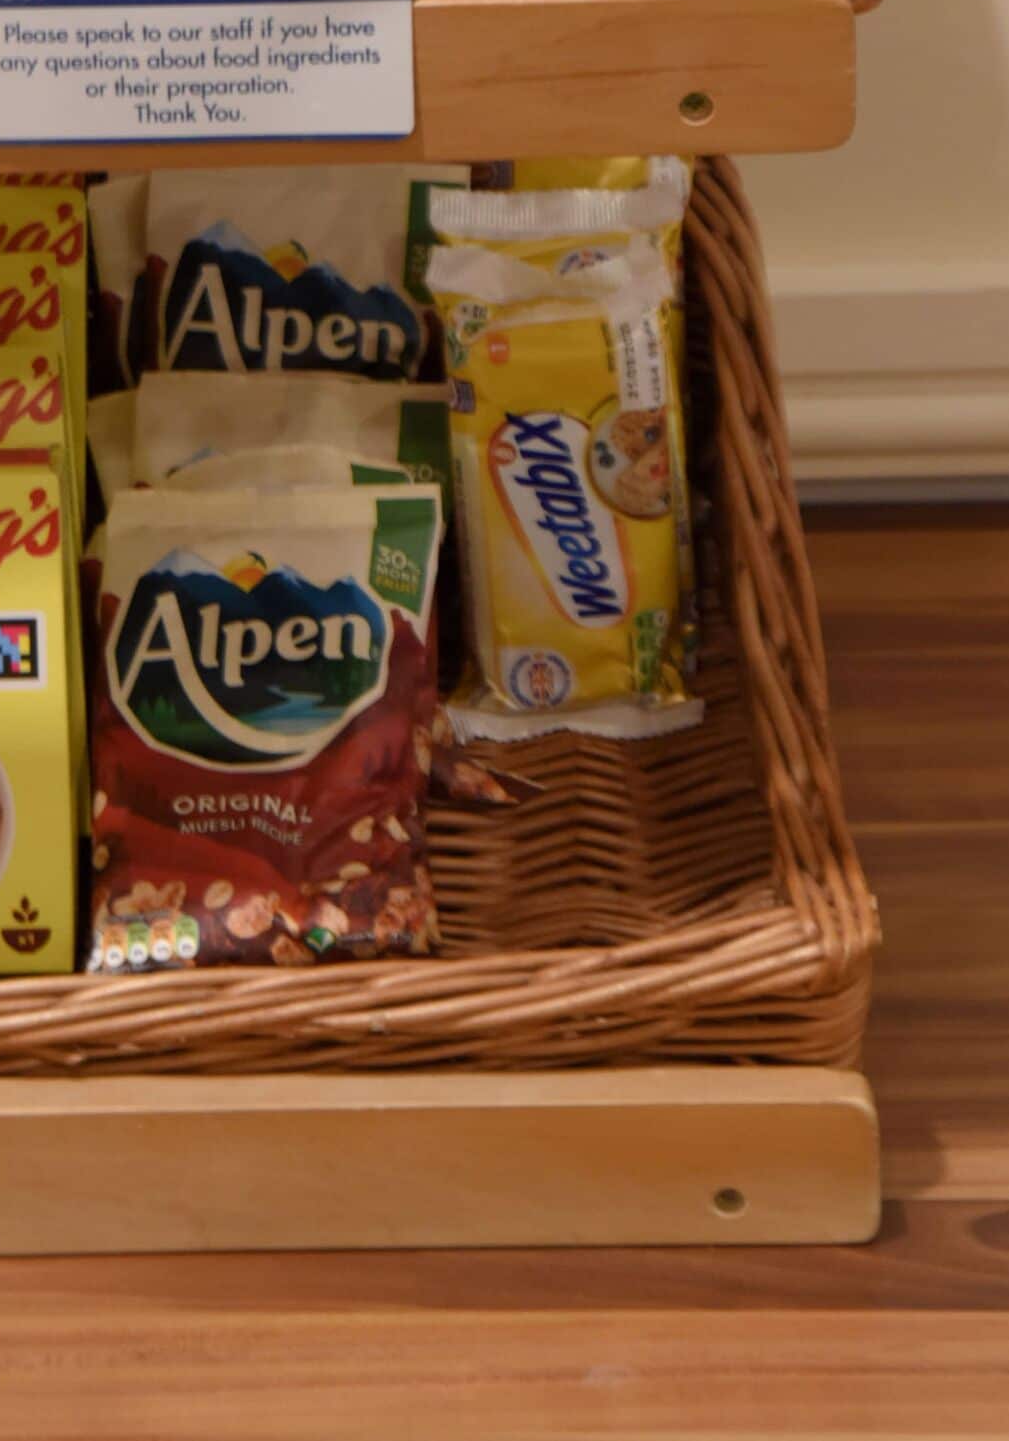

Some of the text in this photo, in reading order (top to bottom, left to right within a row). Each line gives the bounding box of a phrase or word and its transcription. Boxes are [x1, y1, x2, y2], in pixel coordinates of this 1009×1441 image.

[4, 15, 376, 48] Please speak to our staff if you have
[0, 46, 381, 78] any questions about food ingredients
[85, 75, 295, 102] or their preparation.
[135, 101, 247, 124] Thank You.
[505, 412, 626, 619] Weetabix
[119, 591, 372, 725] Alpen
[172, 793, 315, 825] ORIGINAL
